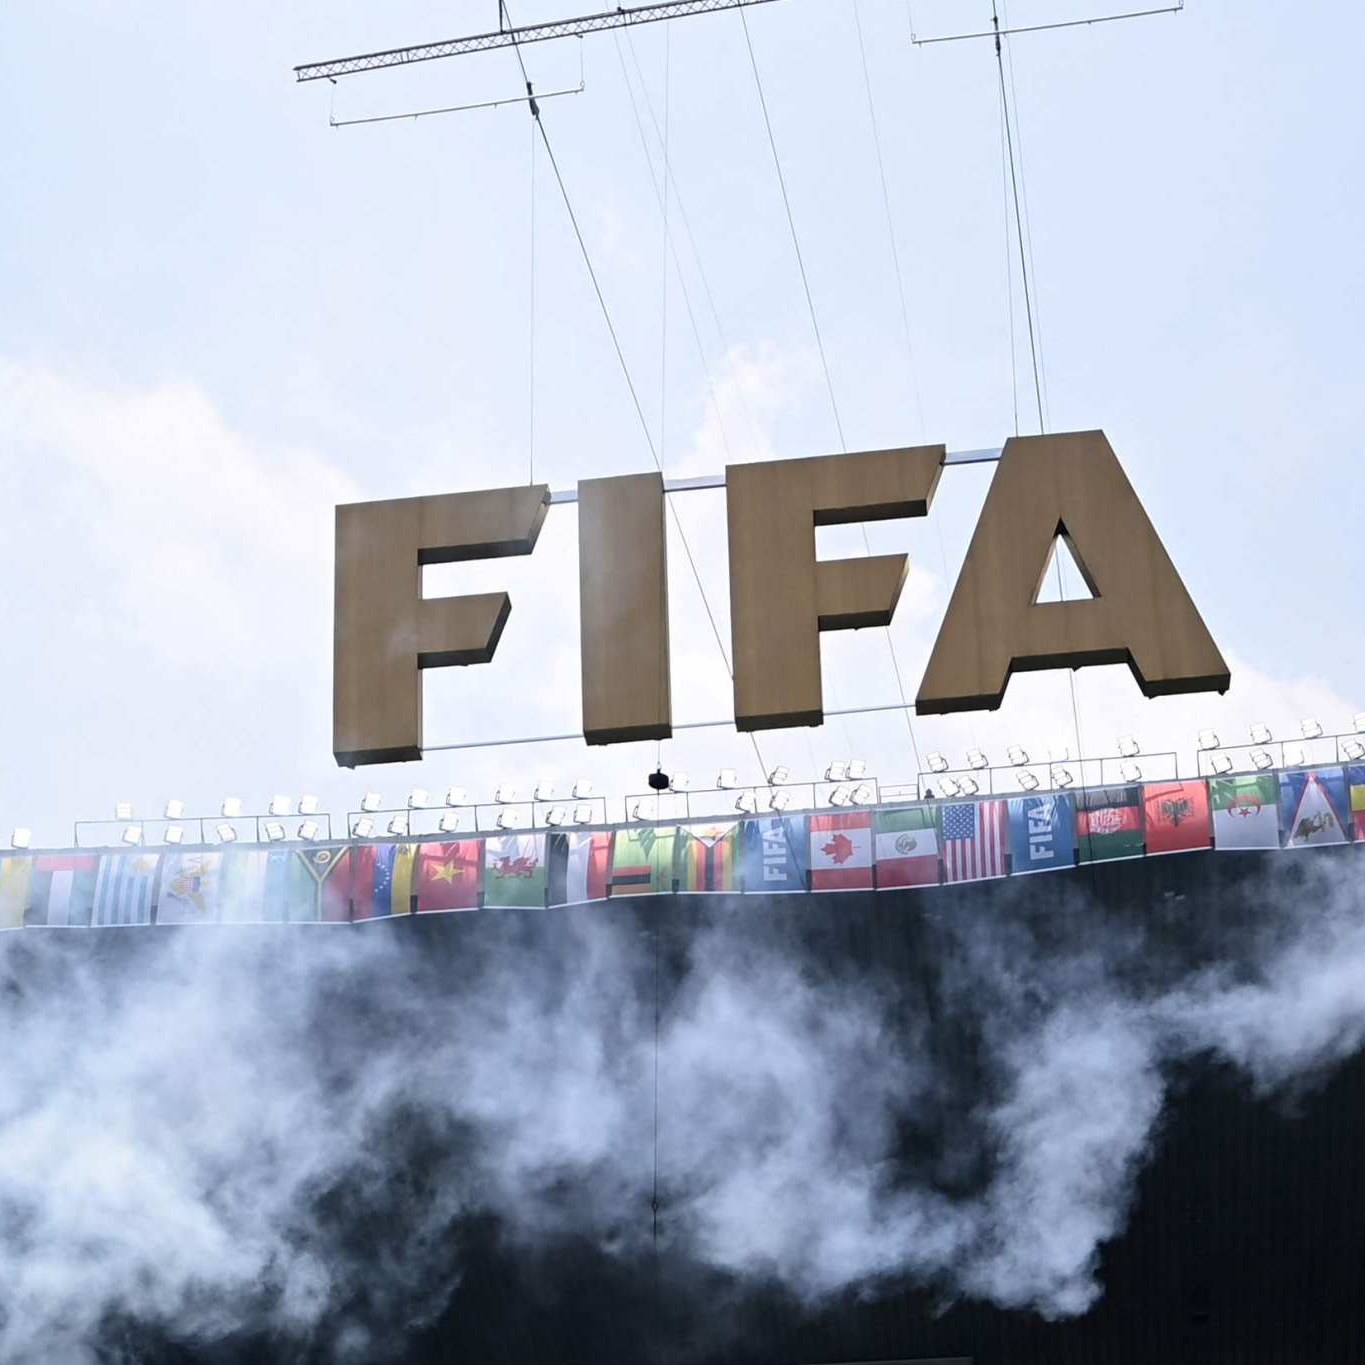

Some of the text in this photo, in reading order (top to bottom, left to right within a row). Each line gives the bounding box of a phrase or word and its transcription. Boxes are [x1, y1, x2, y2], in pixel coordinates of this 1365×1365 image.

[333, 430, 1231, 766] FIFA
[762, 824, 788, 882] FIFA
[1028, 802, 1054, 861] FIFA
